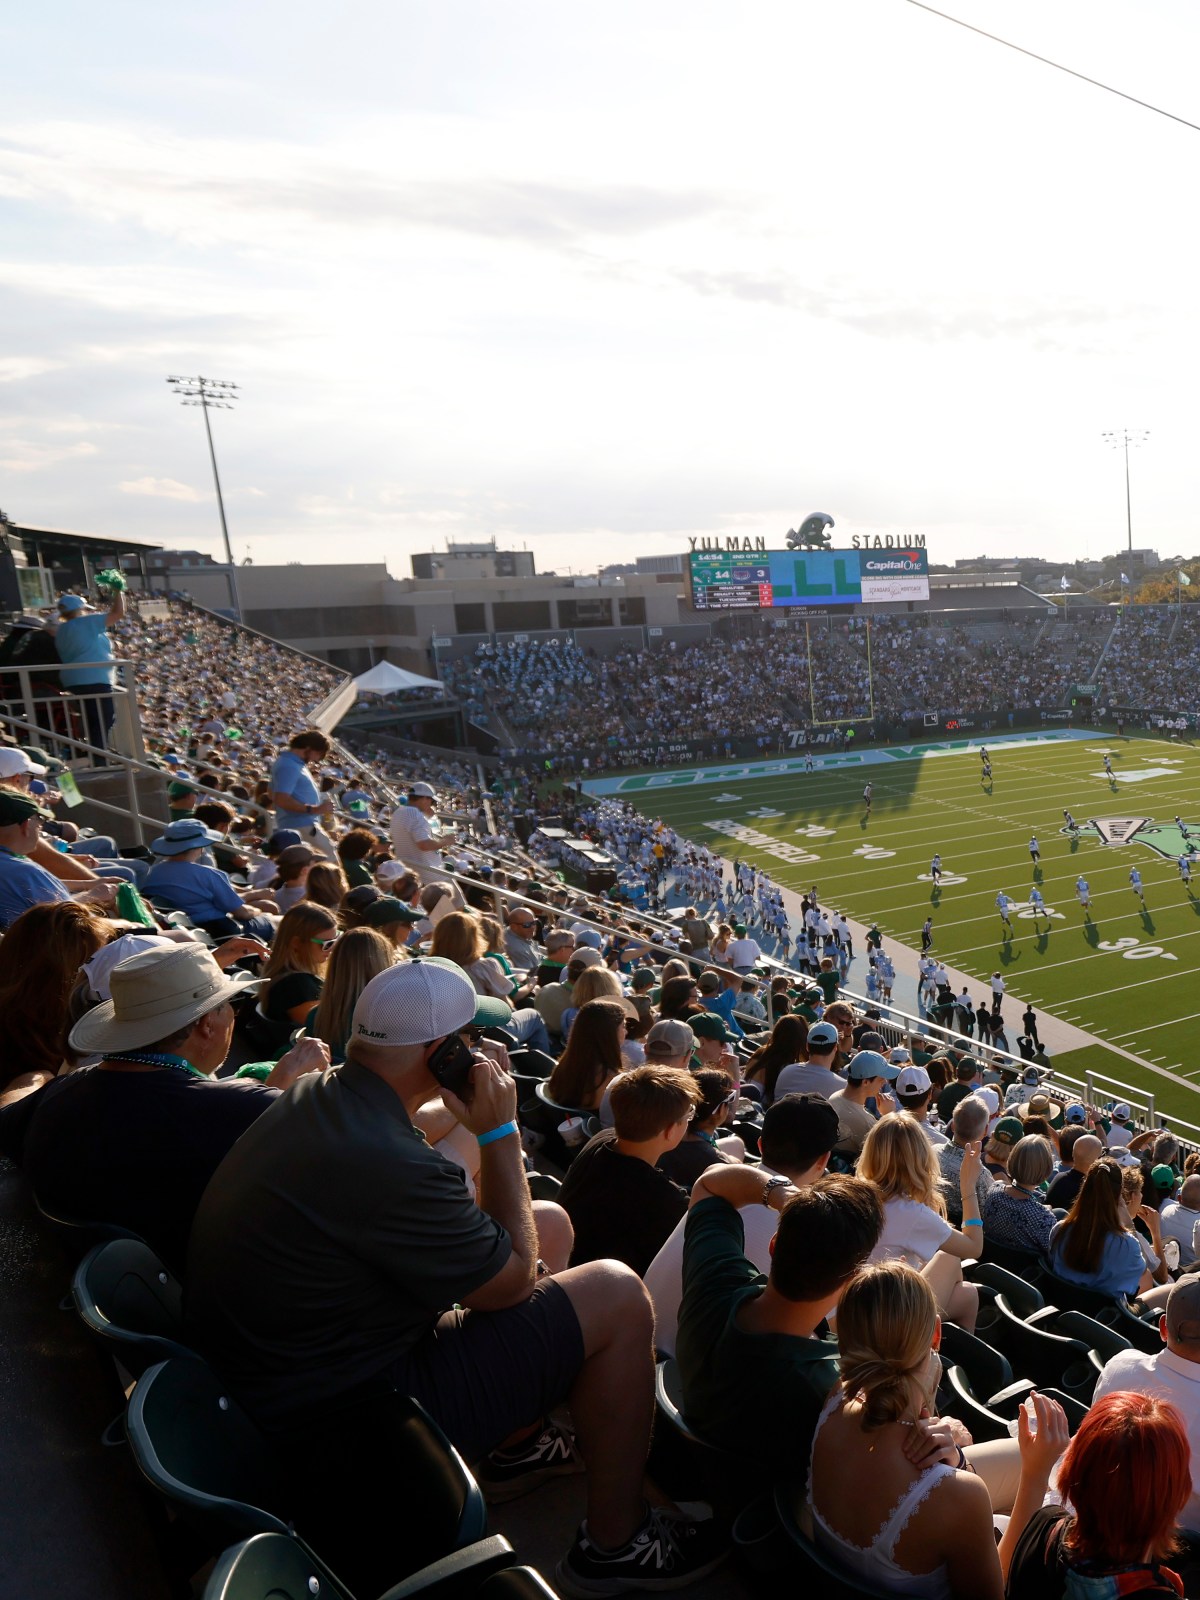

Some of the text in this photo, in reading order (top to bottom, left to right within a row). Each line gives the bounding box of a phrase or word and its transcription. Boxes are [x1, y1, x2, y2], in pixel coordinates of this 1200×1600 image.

[688, 534, 926, 551] YULMAN STADIUM
[715, 570, 730, 579] 14
[757, 569, 764, 577] 3
[794, 825, 837, 837] 30
[702, 819, 821, 864] BENSON FIELD
[852, 846, 897, 859] 40
[1098, 937, 1163, 960] 30
